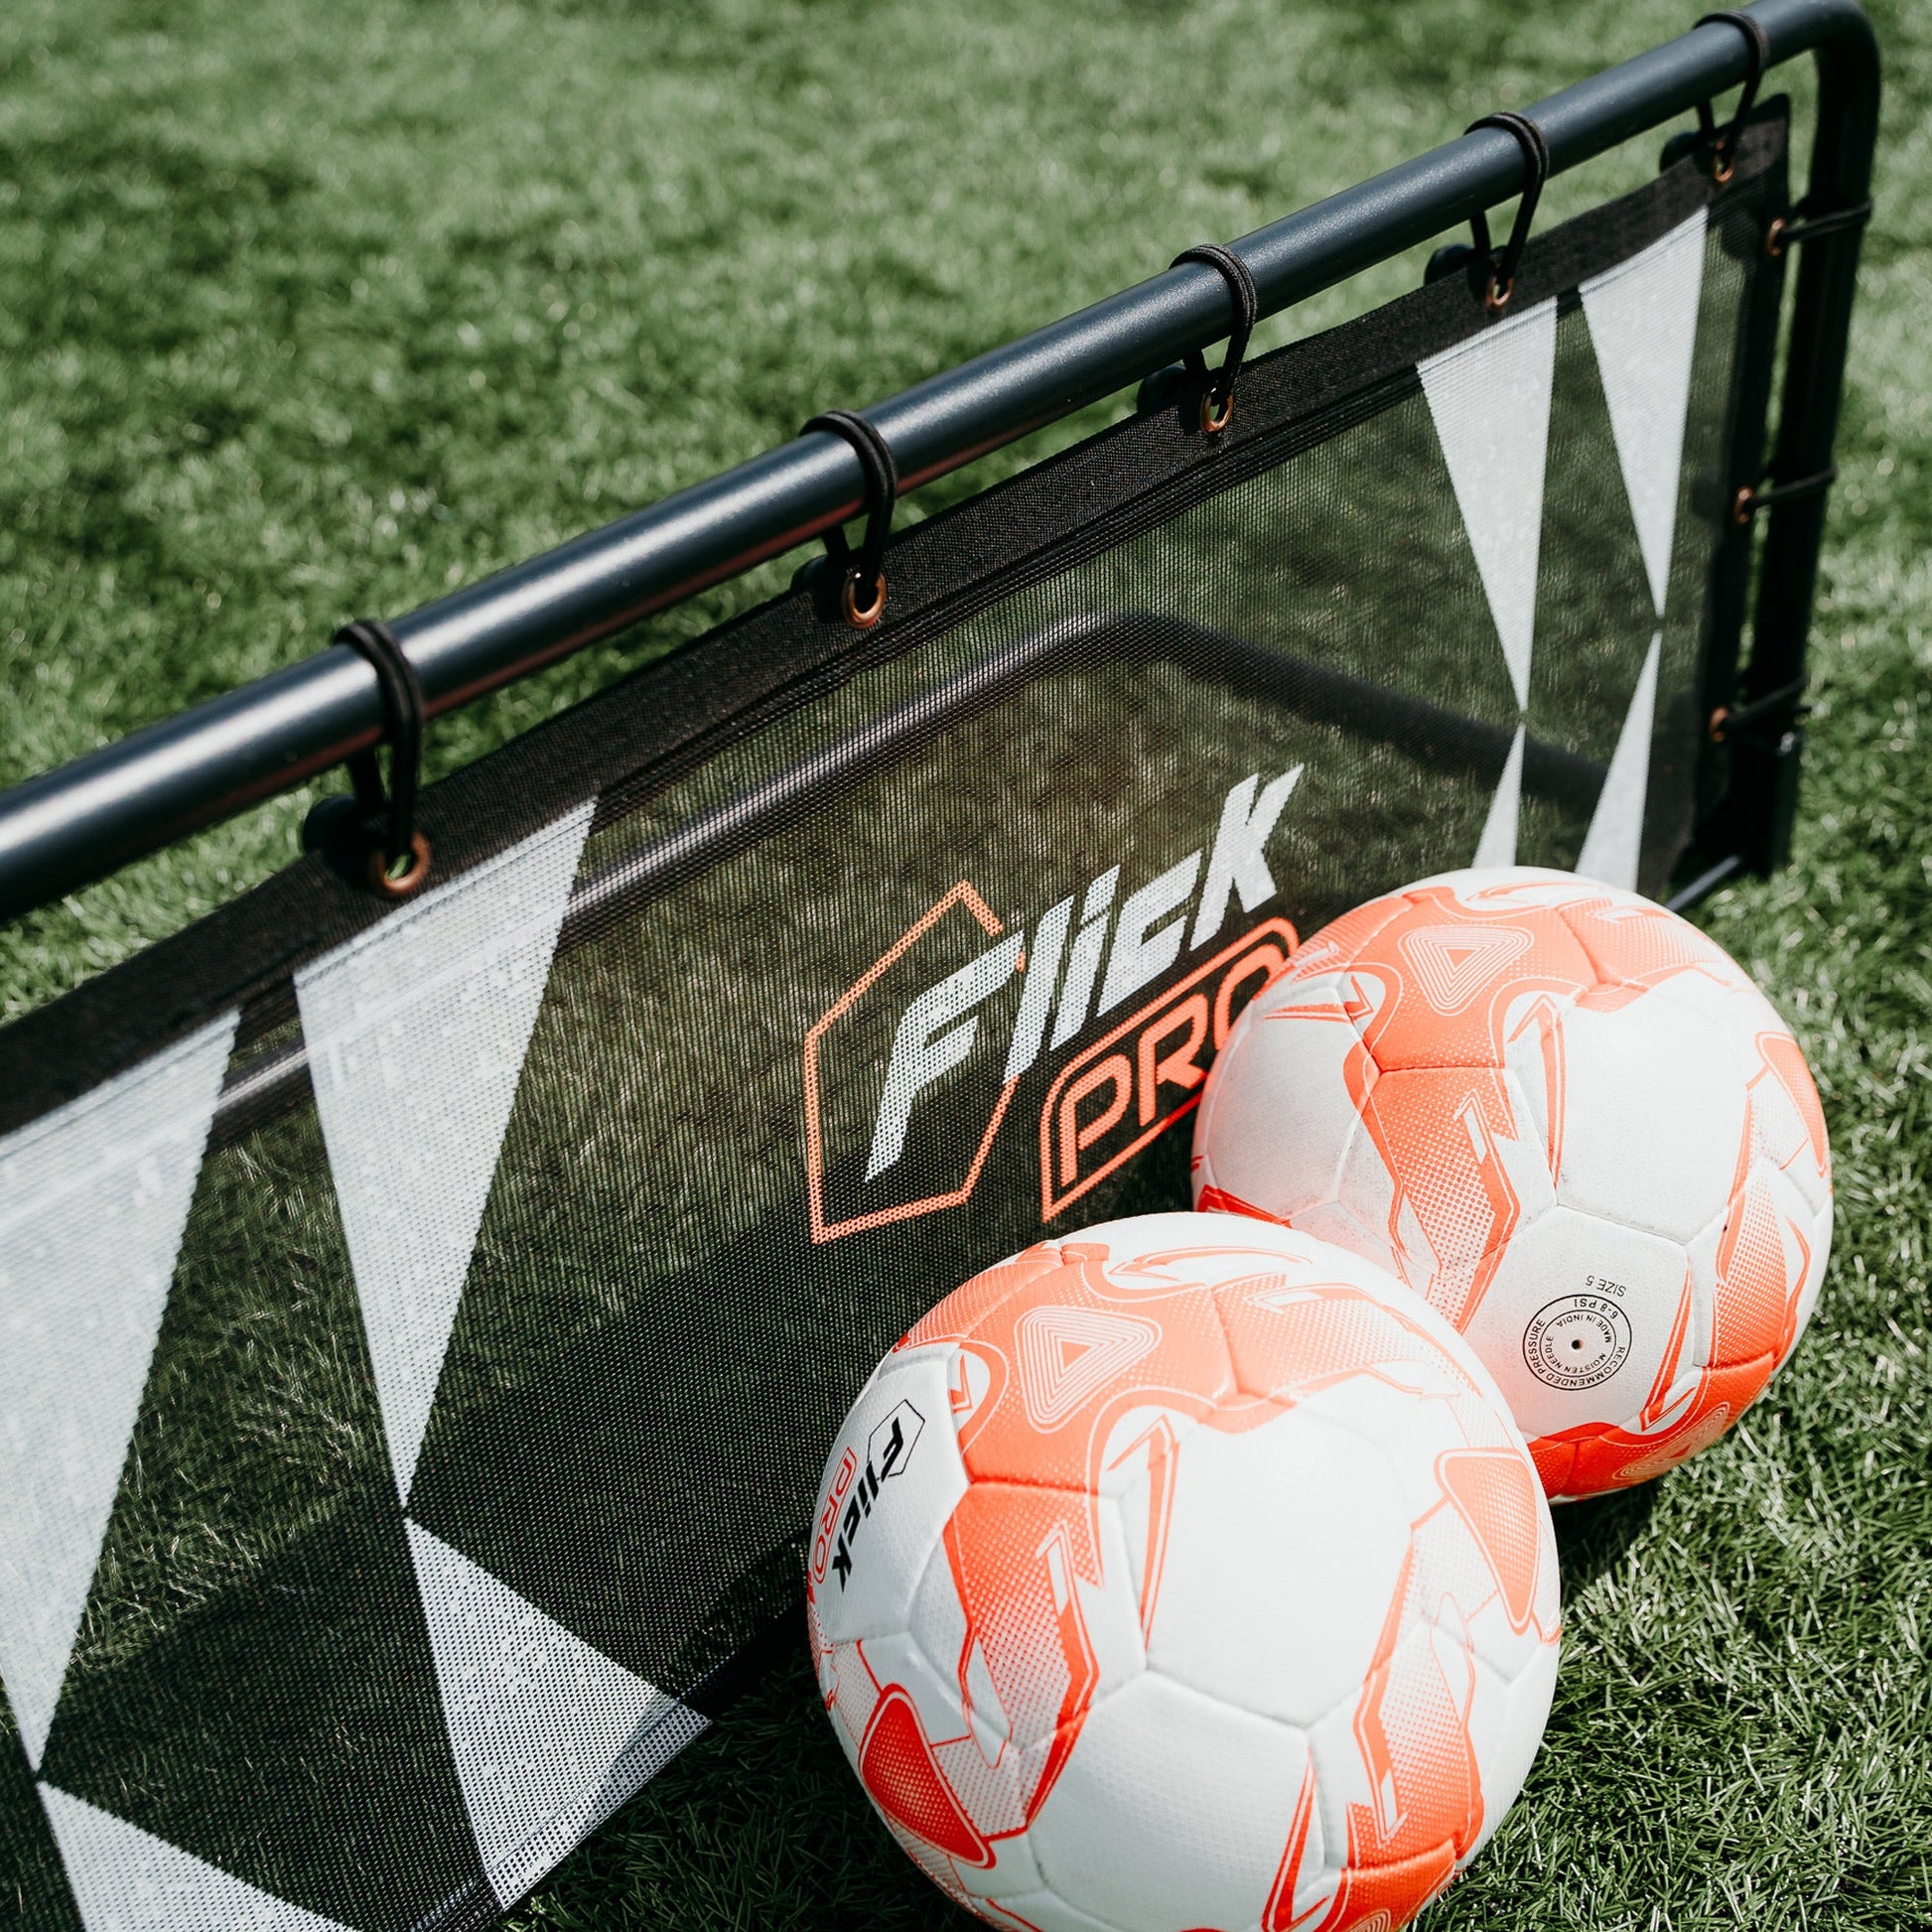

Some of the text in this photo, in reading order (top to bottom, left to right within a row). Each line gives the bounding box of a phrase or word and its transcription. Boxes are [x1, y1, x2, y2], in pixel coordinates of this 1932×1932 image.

[1586, 1275, 1627, 1298] SIZE 5
[1574, 1298, 1619, 1319] 6-8 PSI
[1556, 1313, 1612, 1343] MADE IN INDIA
[1528, 1318, 1626, 1387] RECOMMENDED PRESSURE
[1545, 1335, 1607, 1374] MOISTEN NEEDLE
[814, 1457, 853, 1575] PRO
